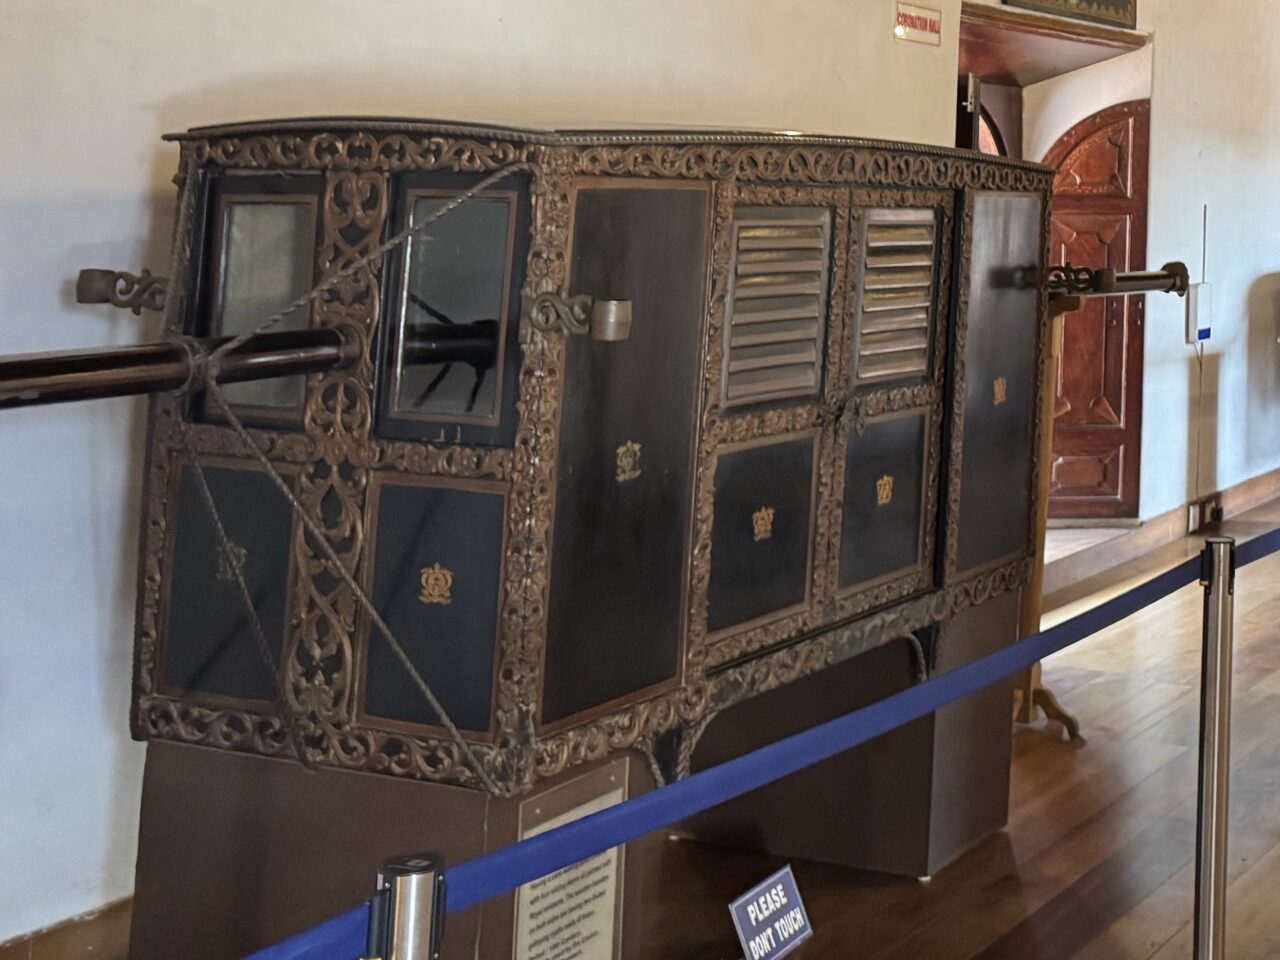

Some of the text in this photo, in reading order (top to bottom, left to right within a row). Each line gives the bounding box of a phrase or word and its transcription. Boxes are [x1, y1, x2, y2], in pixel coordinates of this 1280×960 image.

[747, 883, 788, 926] PLEASE
[749, 906, 804, 960] DON'T TOUCH
